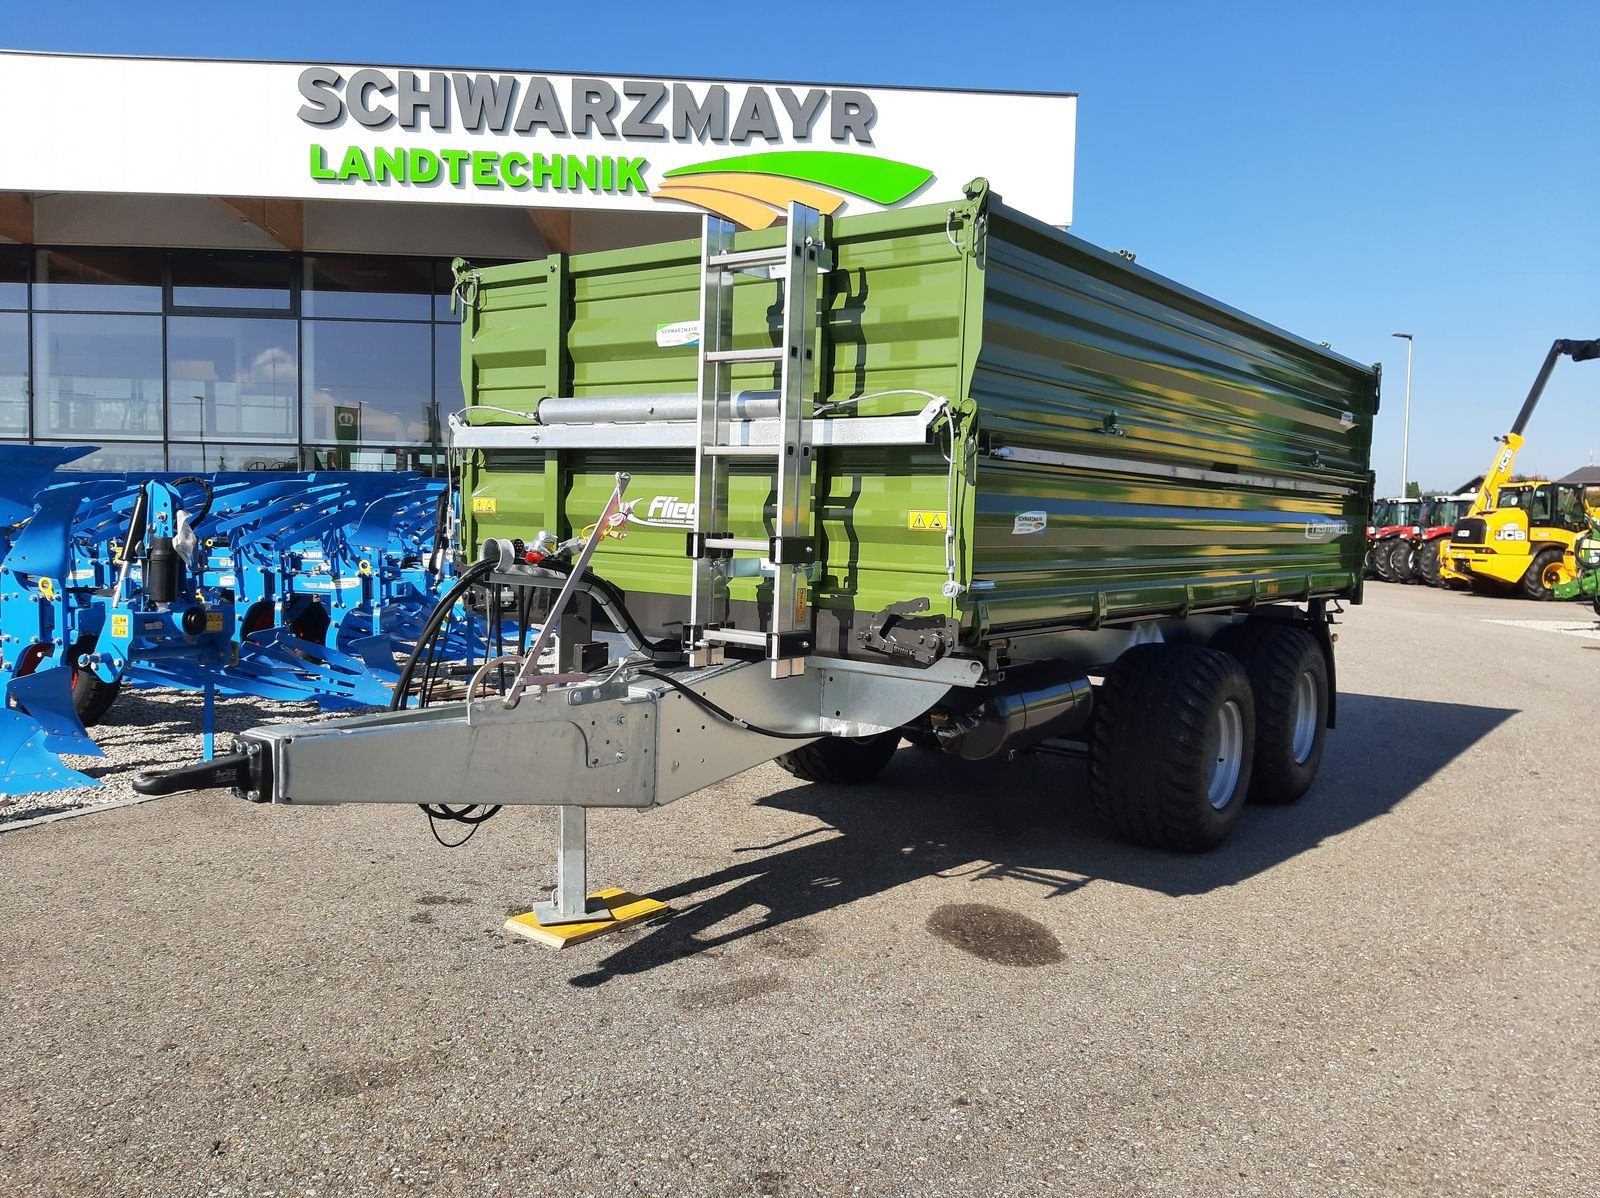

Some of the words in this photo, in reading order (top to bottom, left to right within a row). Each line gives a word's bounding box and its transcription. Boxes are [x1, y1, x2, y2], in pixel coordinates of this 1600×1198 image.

[297, 67, 876, 146] SCHWARZMAYR
[310, 144, 648, 193] LANDTECHNIK
[1499, 448, 1514, 473] JCB
[1495, 530, 1526, 540] JCB
